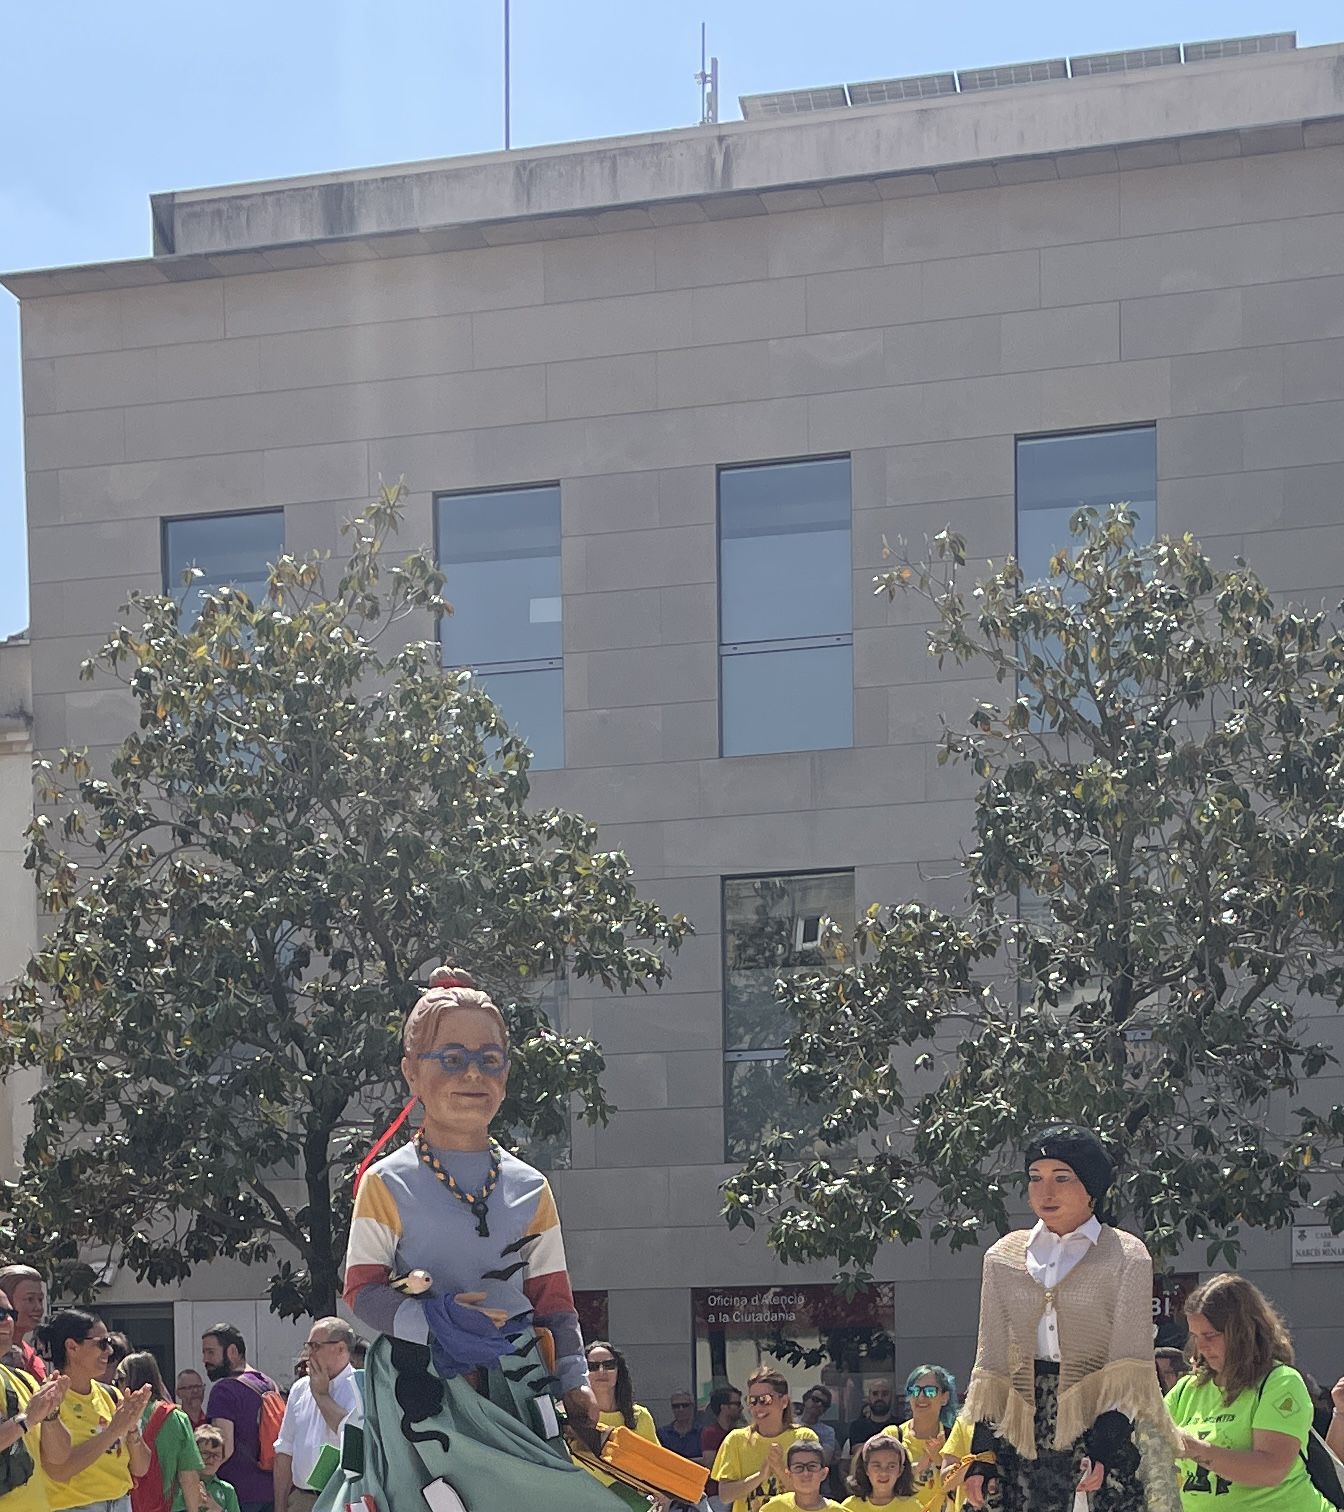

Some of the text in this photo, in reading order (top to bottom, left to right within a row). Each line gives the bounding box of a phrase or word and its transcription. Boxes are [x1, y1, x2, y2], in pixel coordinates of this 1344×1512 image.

[707, 1295, 748, 1307] Oficina
[708, 1314, 716, 1323] a
[719, 1312, 729, 1323] la
